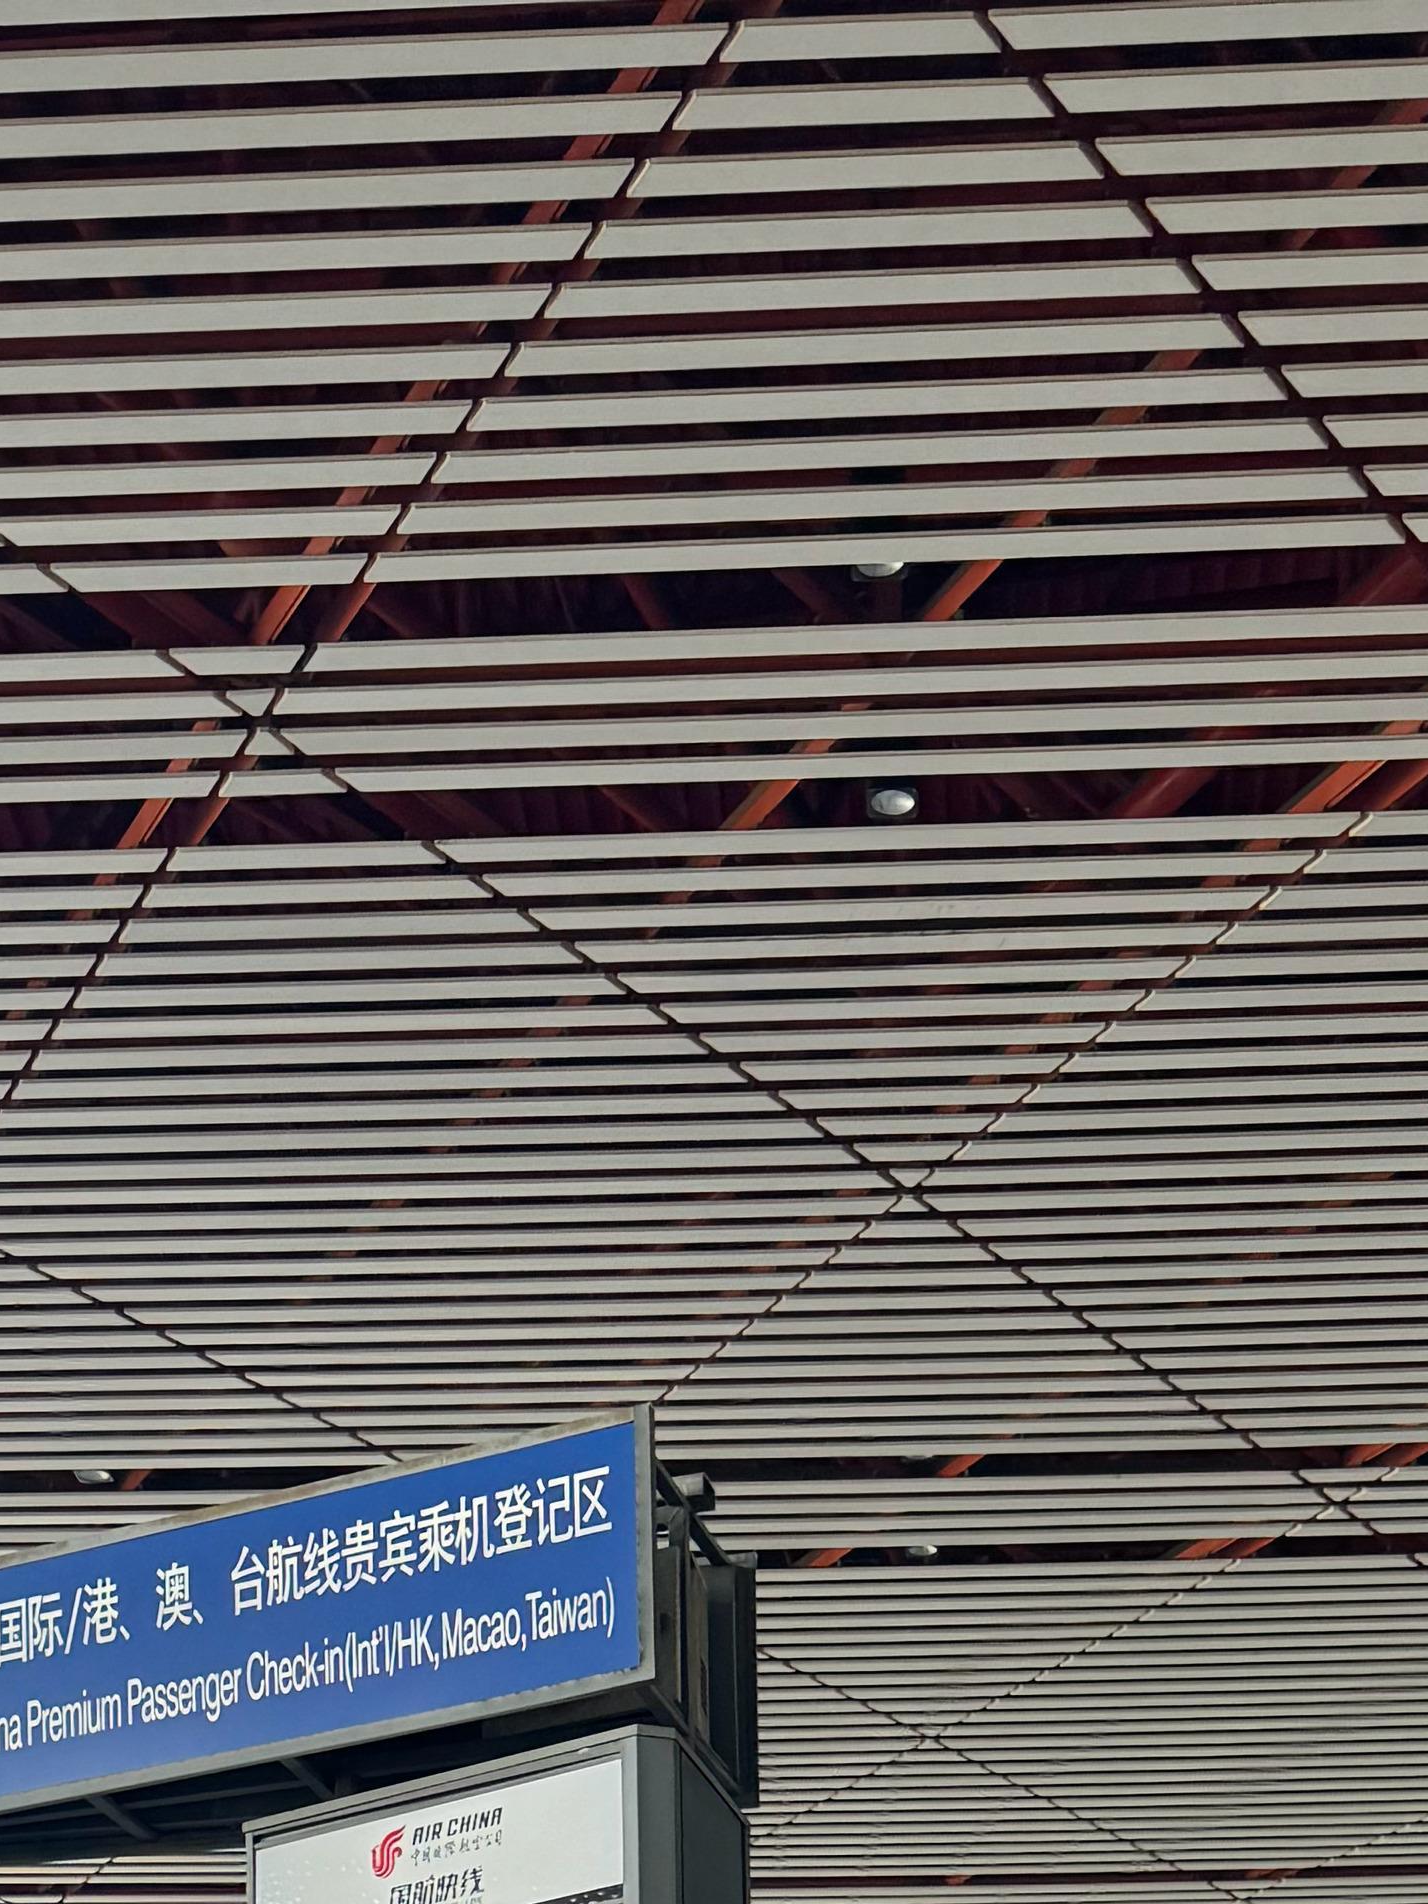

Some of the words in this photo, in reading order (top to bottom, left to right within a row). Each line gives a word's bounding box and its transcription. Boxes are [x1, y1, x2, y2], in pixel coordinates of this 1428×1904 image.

[27, 1689, 122, 1747] Premium
[127, 1667, 242, 1725] Passenger
[412, 1822, 443, 1846] AIR
[447, 1807, 503, 1837] CHINA
